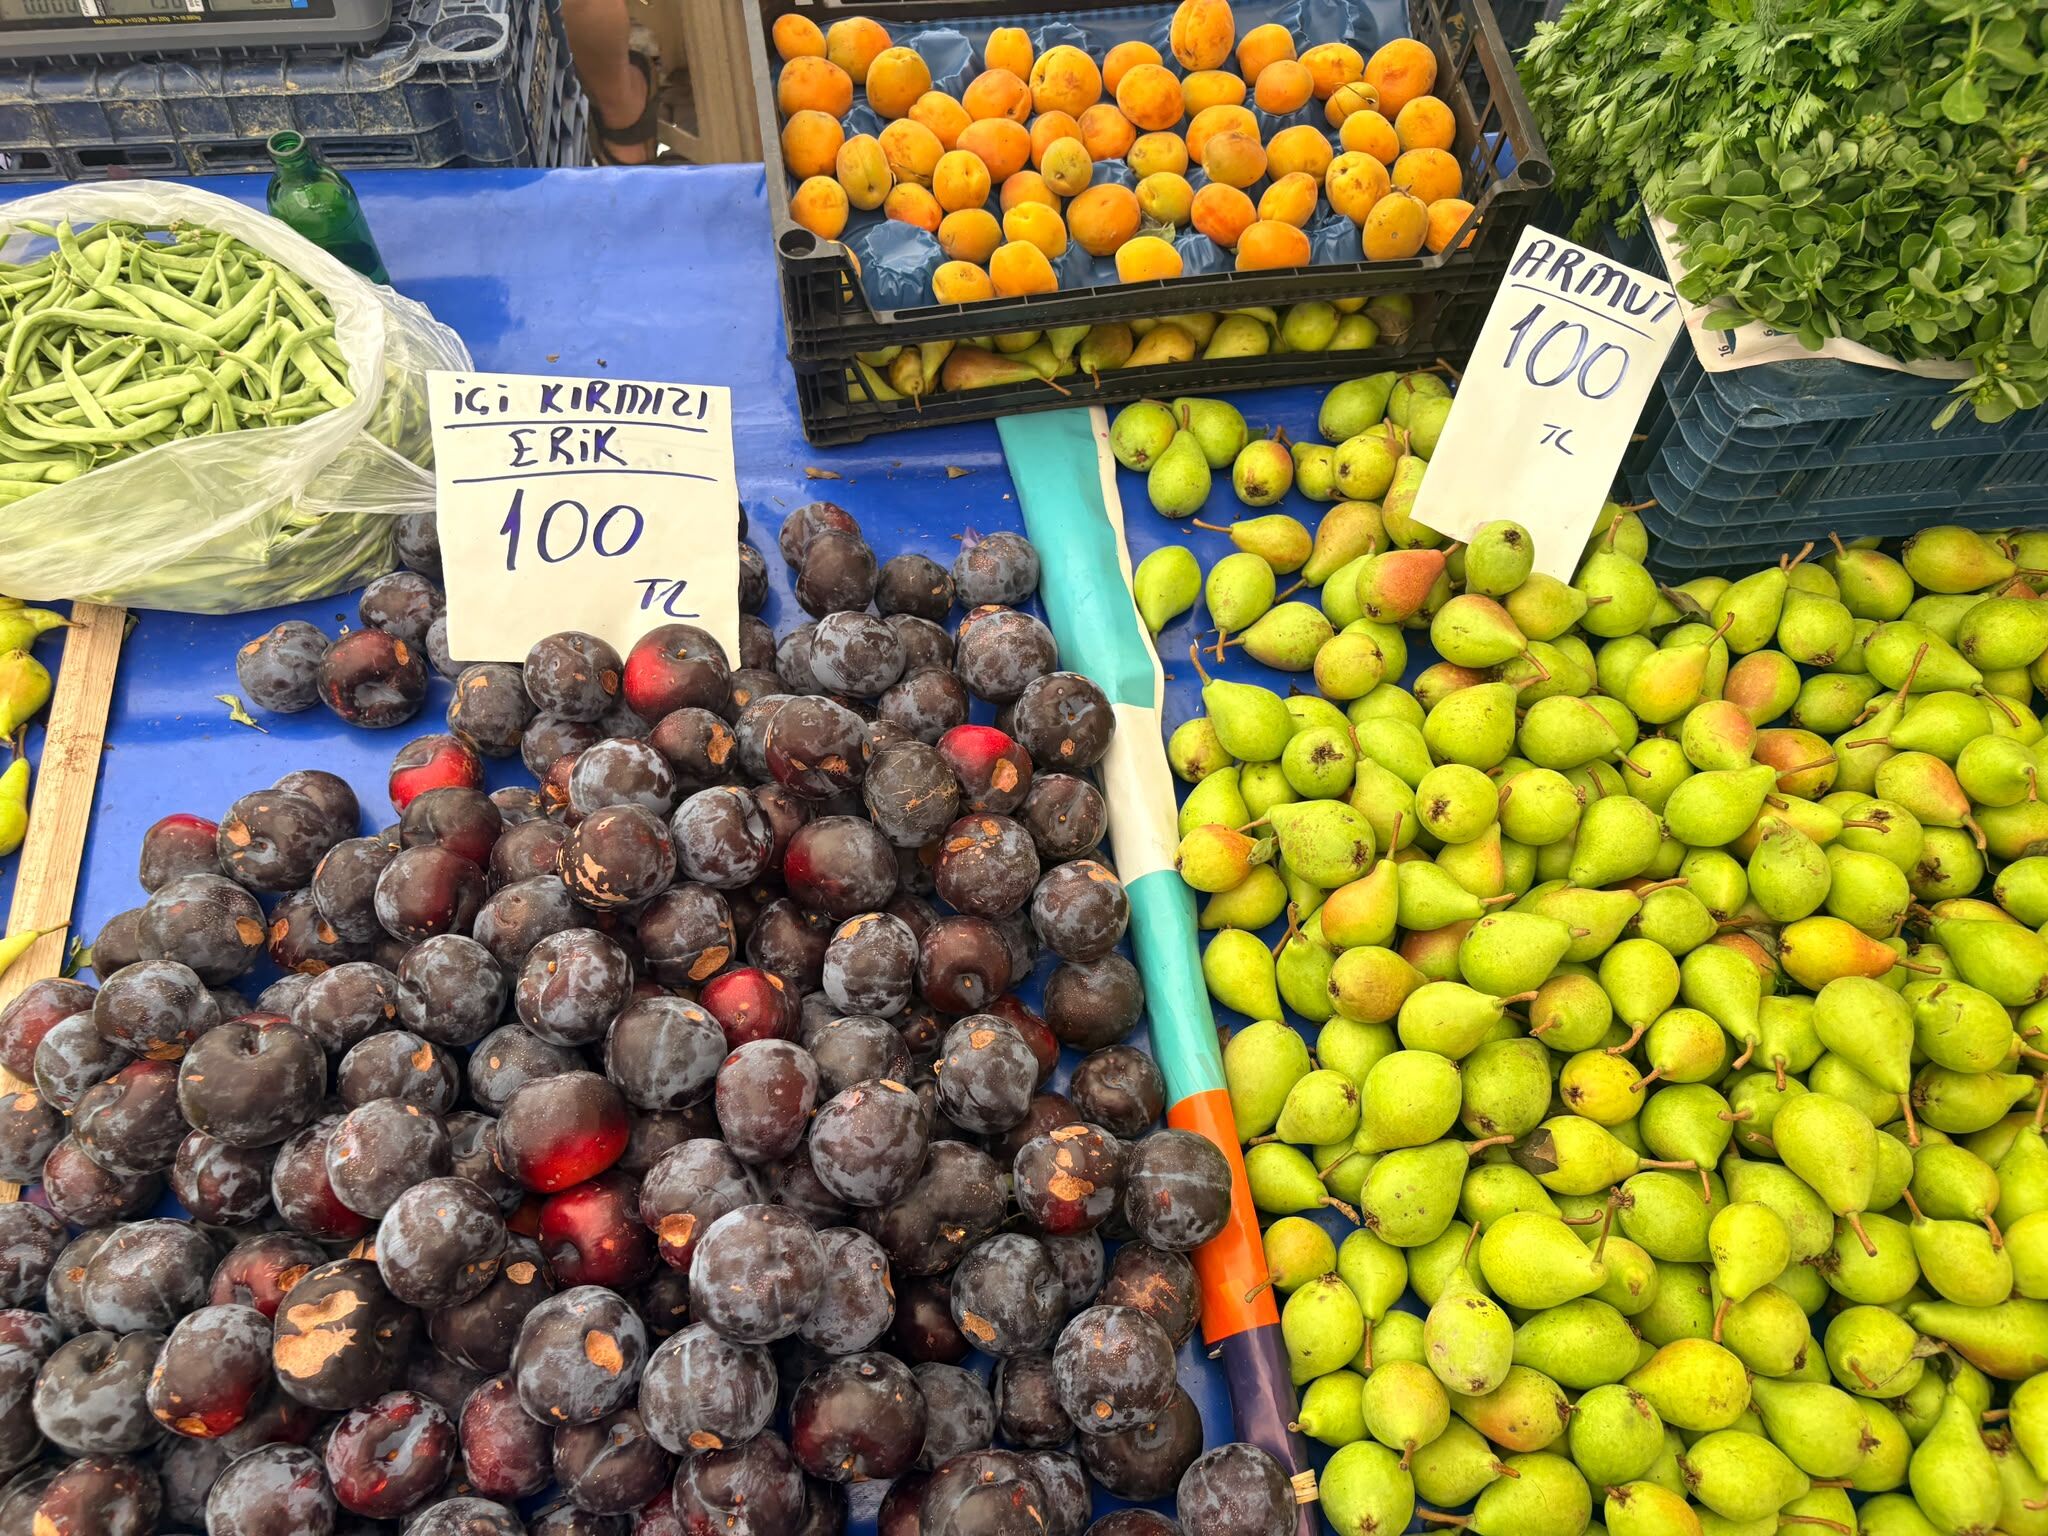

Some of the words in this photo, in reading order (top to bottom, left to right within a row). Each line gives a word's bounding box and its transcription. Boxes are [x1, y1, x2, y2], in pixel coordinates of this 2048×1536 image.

[1503, 304, 1630, 400] 100
[540, 380, 708, 420] KIRMIZI
[500, 488, 644, 571] 100
[634, 578, 700, 618] TL
